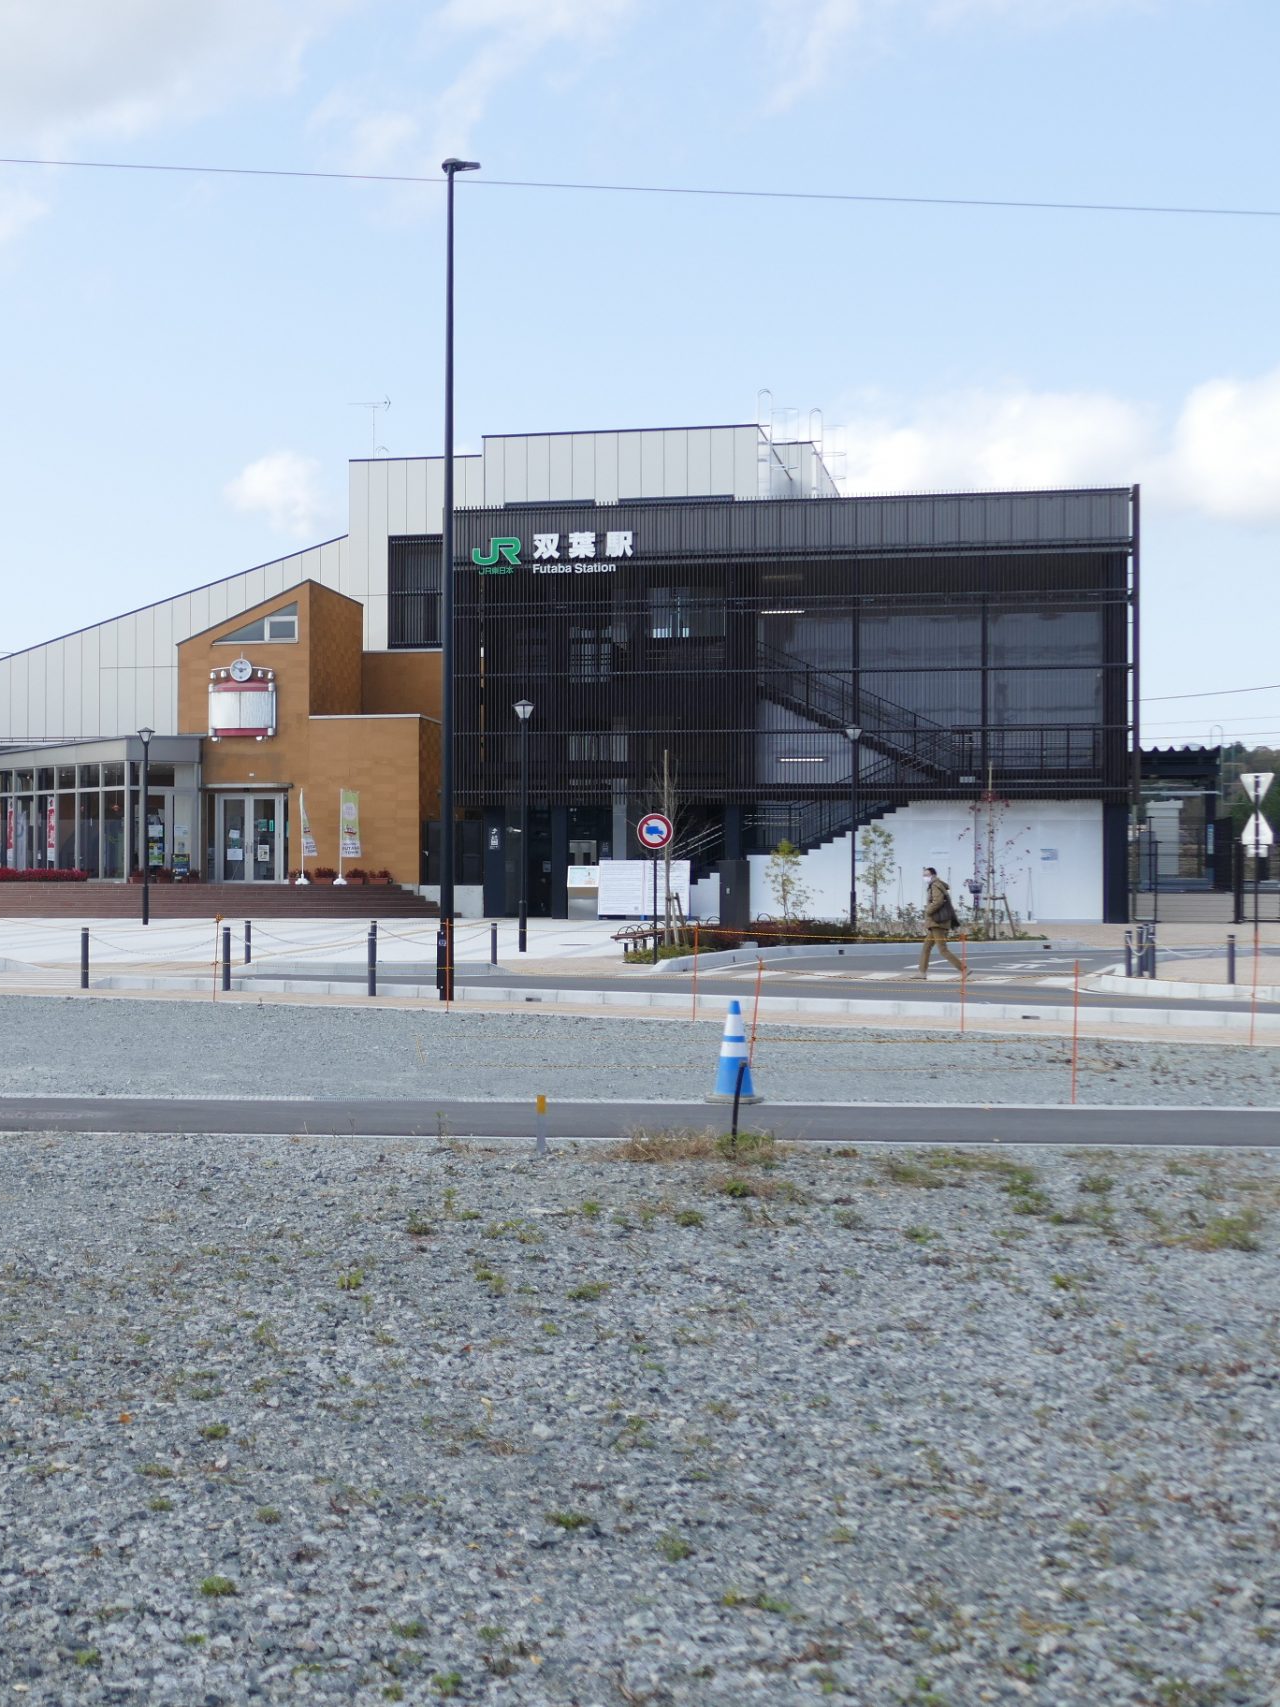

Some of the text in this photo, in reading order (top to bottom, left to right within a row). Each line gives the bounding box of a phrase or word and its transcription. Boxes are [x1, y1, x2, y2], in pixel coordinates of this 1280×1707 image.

[471, 536, 522, 566] JR
[532, 530, 634, 560] 双葉駅
[478, 566, 515, 576] JR東日本
[532, 562, 616, 574] Futaba Station
